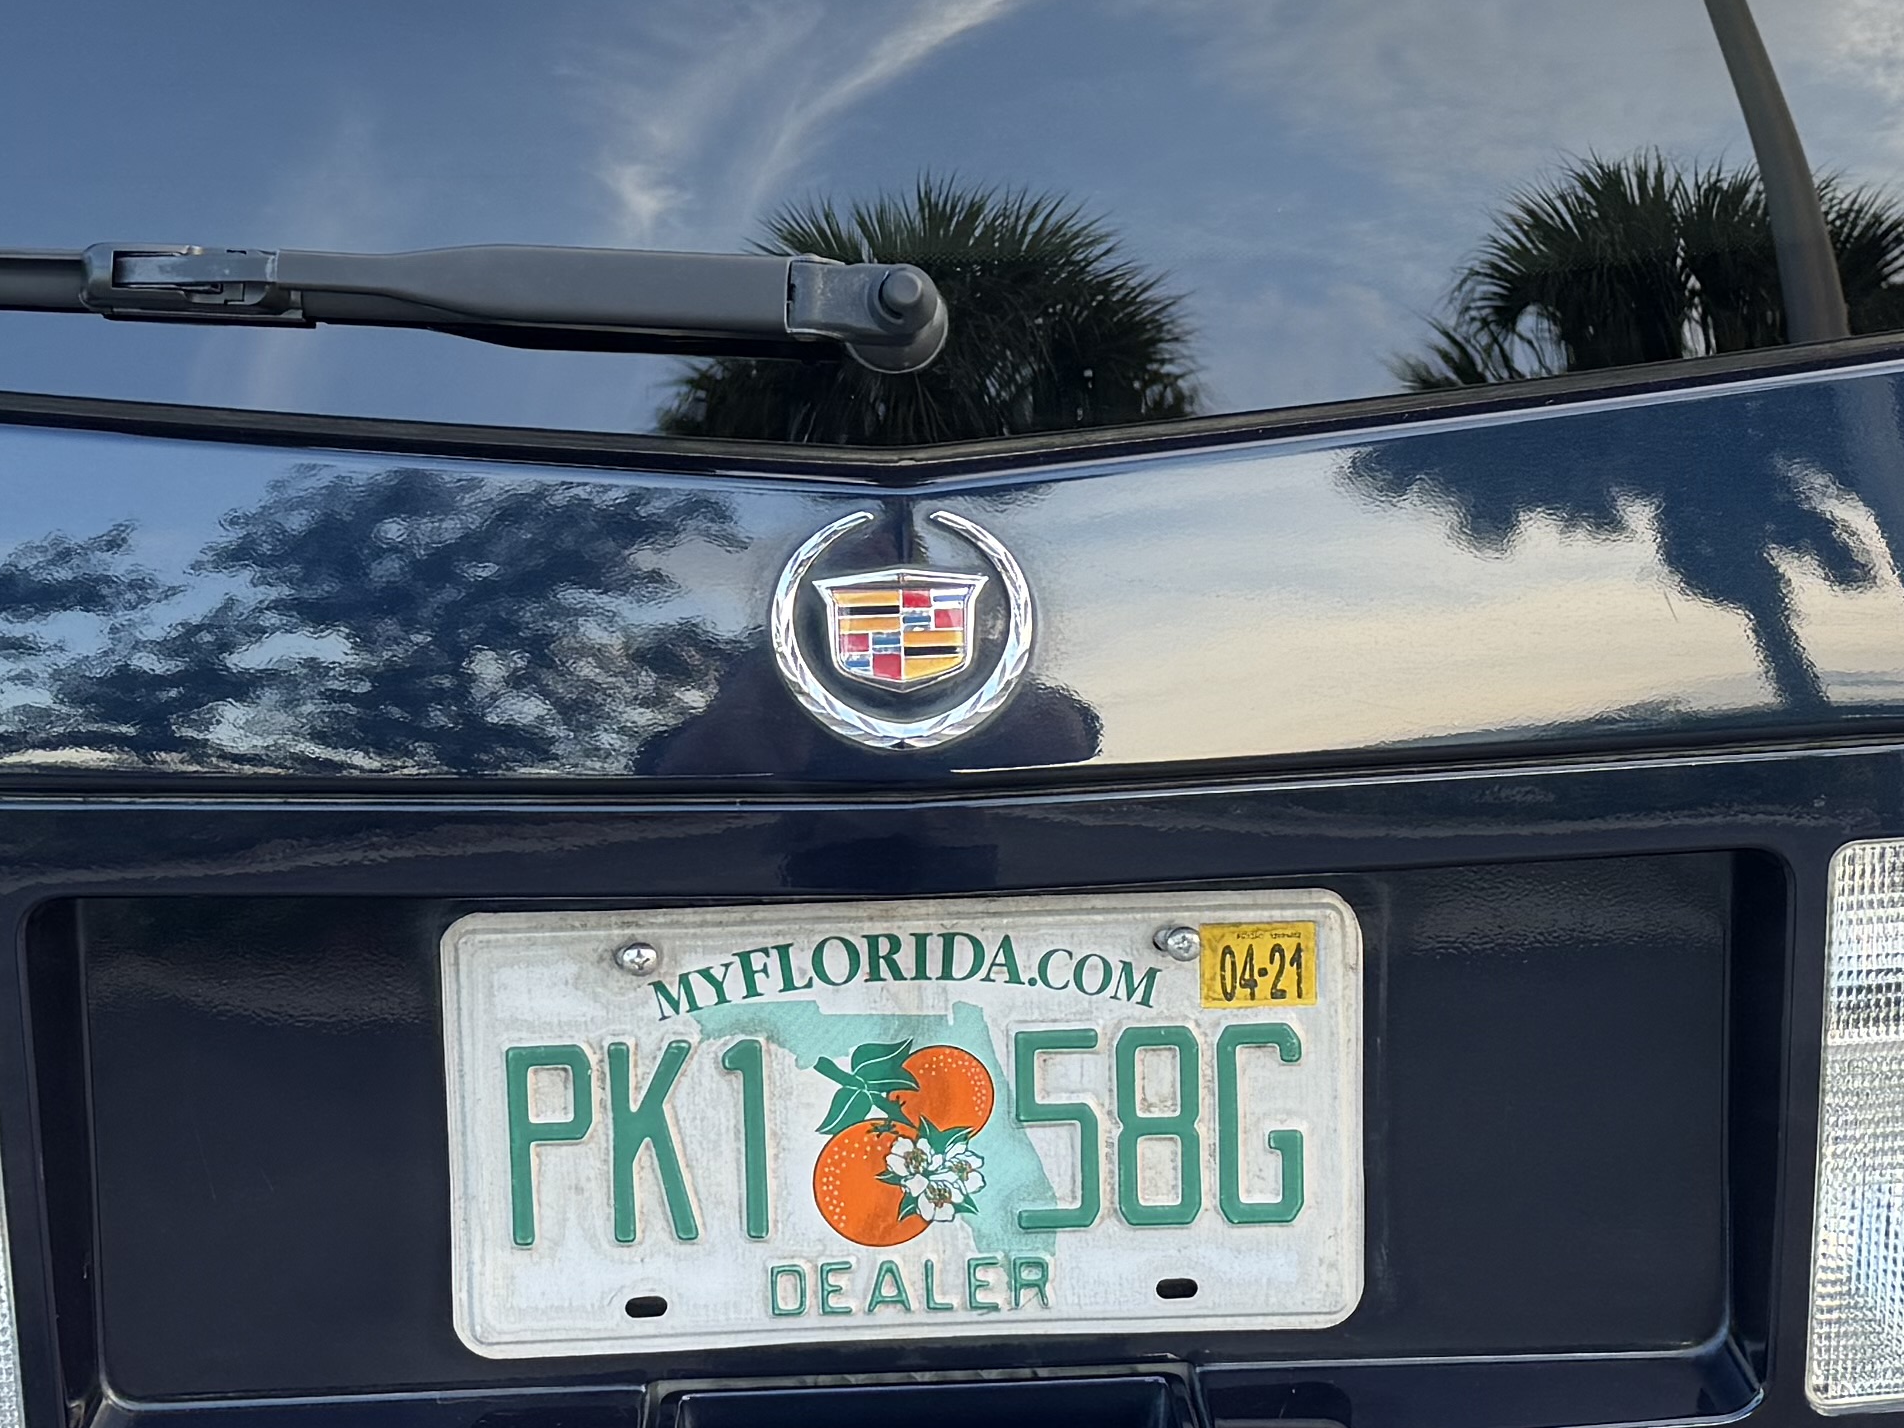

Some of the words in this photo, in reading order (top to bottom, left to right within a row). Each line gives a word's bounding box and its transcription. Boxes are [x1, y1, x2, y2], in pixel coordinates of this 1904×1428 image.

[647, 930, 1163, 1023] MYFLORIDA.COM
[1219, 942, 1303, 1002] 04-21
[505, 1036, 770, 1248] PK1
[1013, 1020, 1305, 1232] 58G
[768, 1254, 1057, 1319] DEALER
